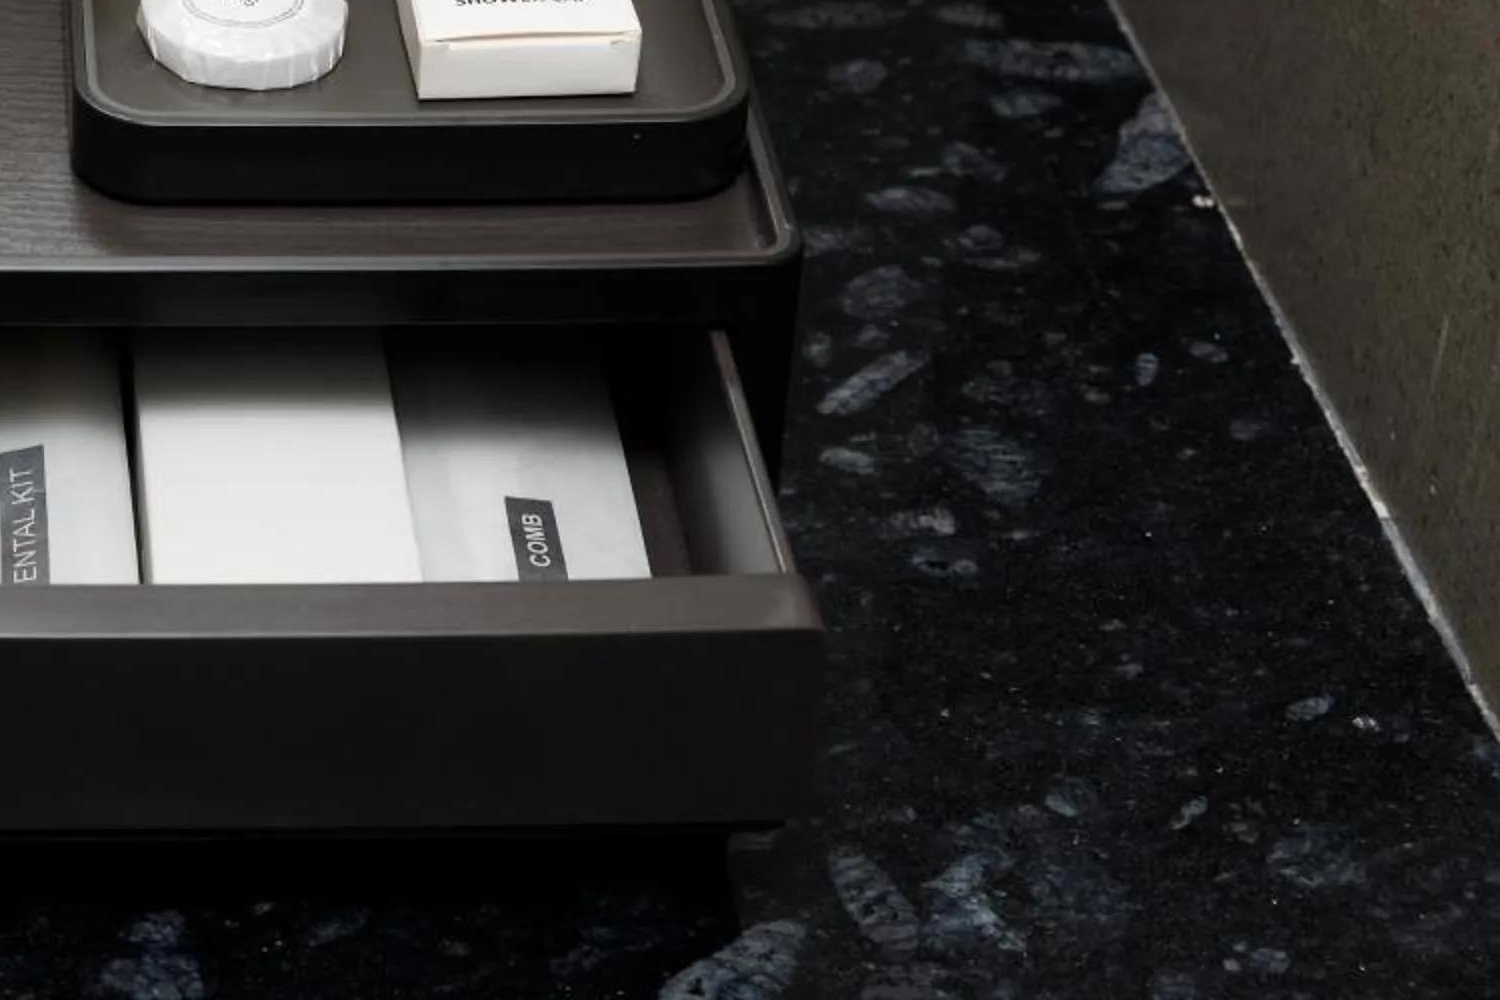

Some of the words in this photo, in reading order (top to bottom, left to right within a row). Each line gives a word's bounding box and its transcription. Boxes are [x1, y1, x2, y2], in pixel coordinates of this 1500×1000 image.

[8, 467, 36, 505] KIT
[12, 507, 37, 584] ENTAL
[521, 513, 551, 568] COMB
